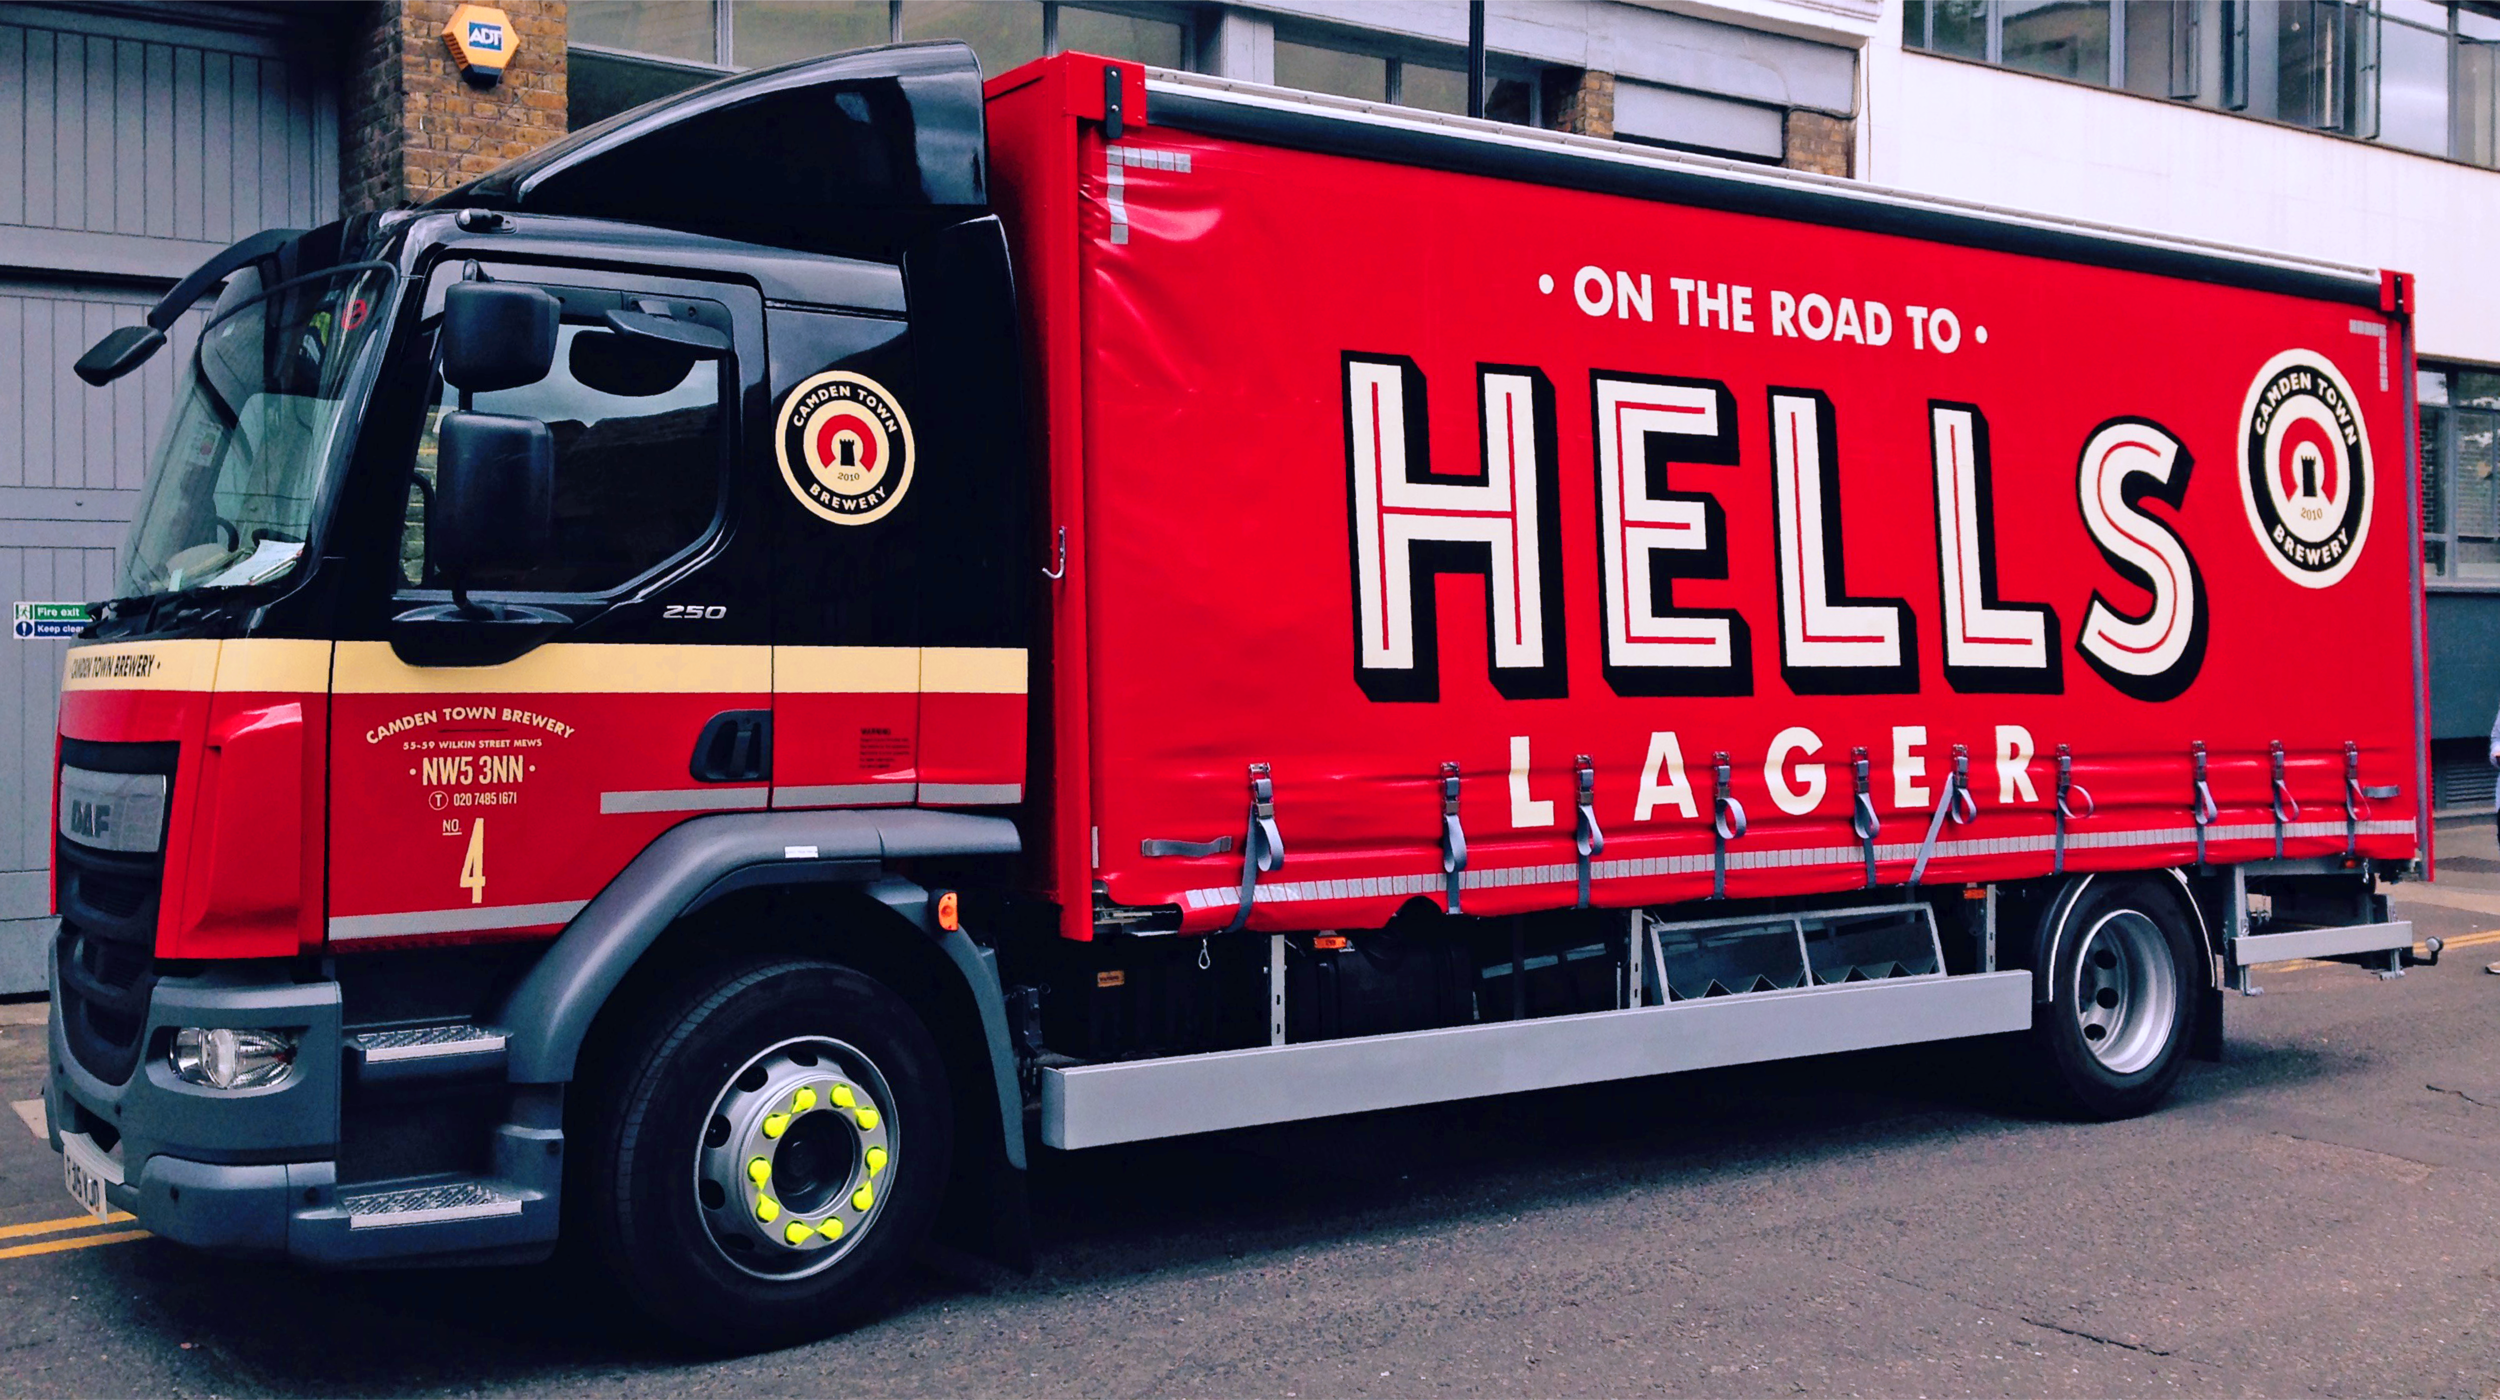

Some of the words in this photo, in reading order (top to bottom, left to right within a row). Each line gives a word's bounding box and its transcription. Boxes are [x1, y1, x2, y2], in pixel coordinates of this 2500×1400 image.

[469, 27, 502, 46] ADT
[1573, 265, 1654, 323] ON
[1669, 277, 1755, 335] THE
[1770, 290, 1893, 347] ROAD
[1906, 305, 1962, 354] TO
[793, 385, 850, 427] CAMDEN
[857, 389, 897, 433] TOWN
[2255, 371, 2312, 435] CAMDEN
[2317, 378, 2358, 446] TOWN
[837, 472, 860, 481] 2010
[809, 482, 886, 511] BREWERY
[1341, 349, 2209, 702] HELLS
[2300, 507, 2323, 521] 2010
[2272, 523, 2349, 566] BREWERY
[37, 607, 58, 617] Fire
[60, 607, 80, 617] exit
[662, 604, 727, 619] 250
[37, 624, 61, 634] Keep
[92, 655, 115, 678] TOWN
[113, 654, 155, 678] BREWERY
[366, 710, 438, 744] CAMDEN
[443, 706, 497, 721] TOWN
[502, 708, 575, 739] BREWERY
[403, 741, 436, 750] 55-59
[439, 740, 476, 749] WILKIN
[478, 739, 511, 748] STREET
[513, 738, 543, 747] MEWS
[422, 756, 474, 786] NW5
[478, 755, 524, 784] 3NN
[1508, 724, 2039, 828] LAGER
[453, 793, 472, 806] 020
[474, 792, 497, 805] 7485
[498, 791, 517, 805] 1671
[459, 817, 486, 904] 4
